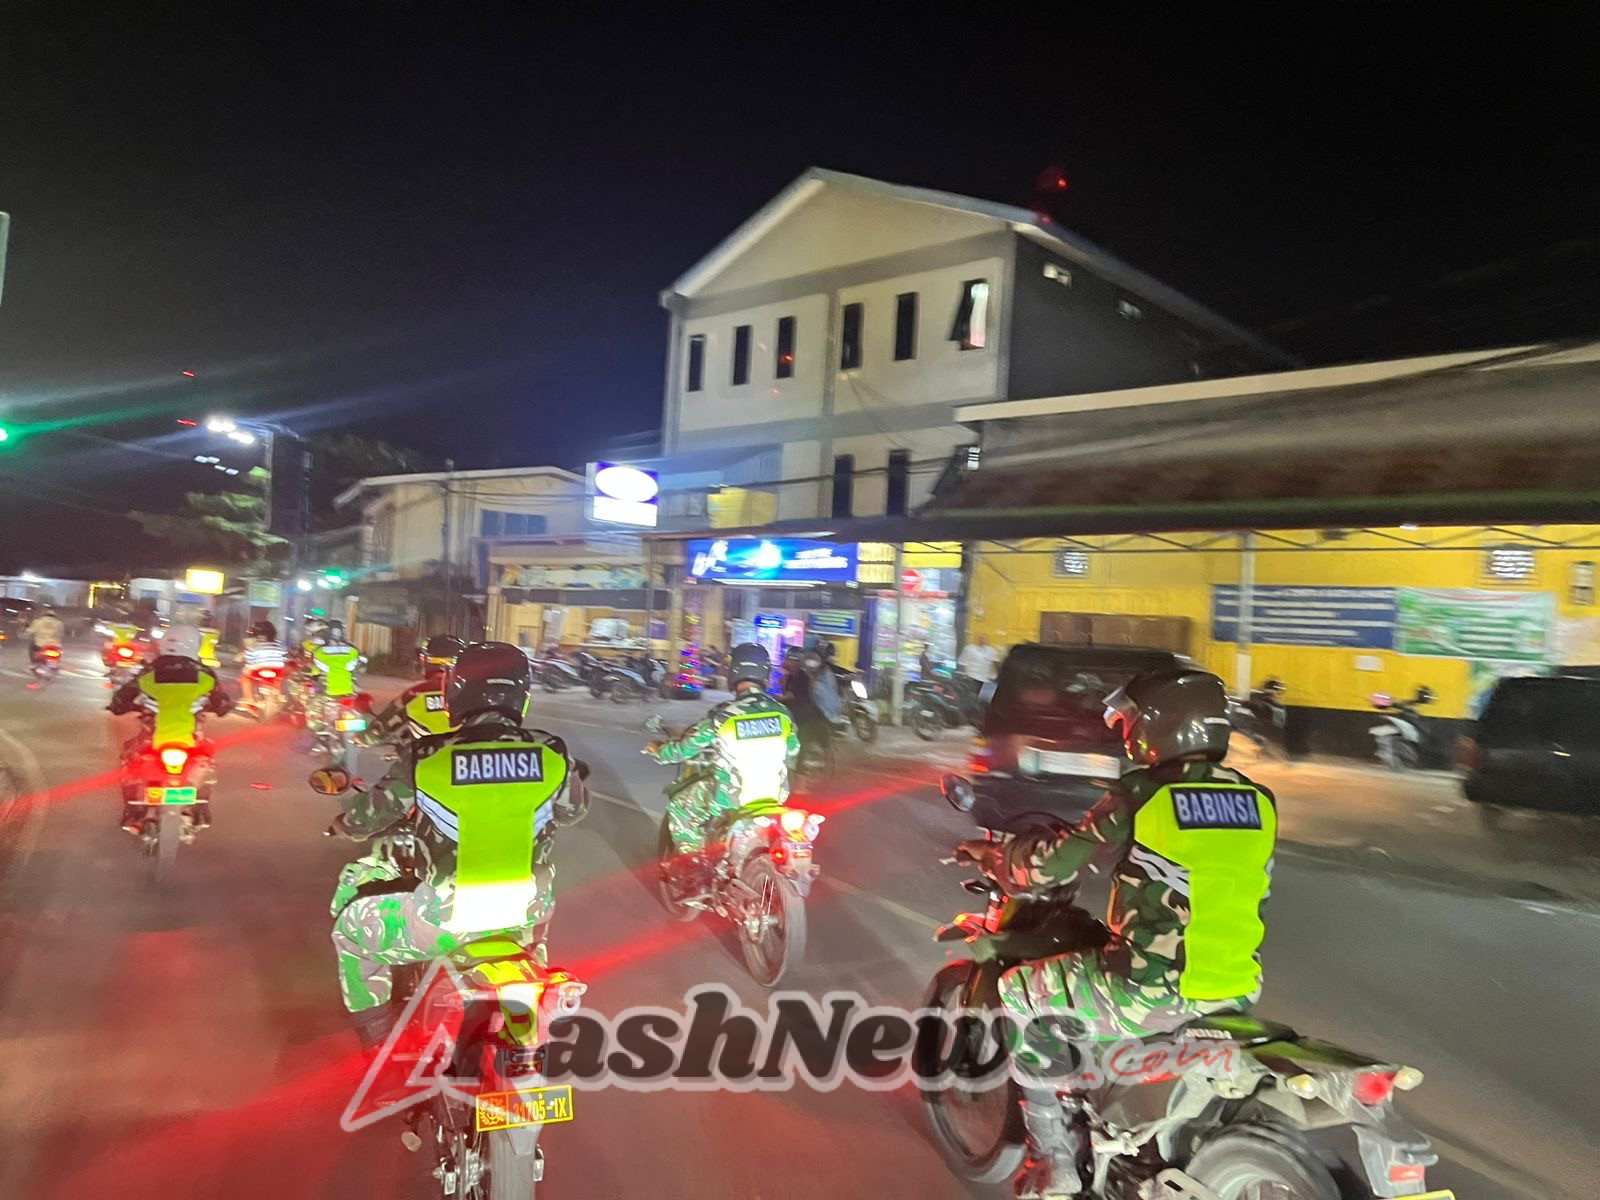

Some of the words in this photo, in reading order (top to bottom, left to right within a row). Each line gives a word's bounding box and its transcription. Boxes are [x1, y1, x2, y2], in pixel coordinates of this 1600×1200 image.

[736, 717, 783, 738] BABINSA
[455, 752, 542, 780] BABINSA
[1174, 792, 1261, 825] BABINSA
